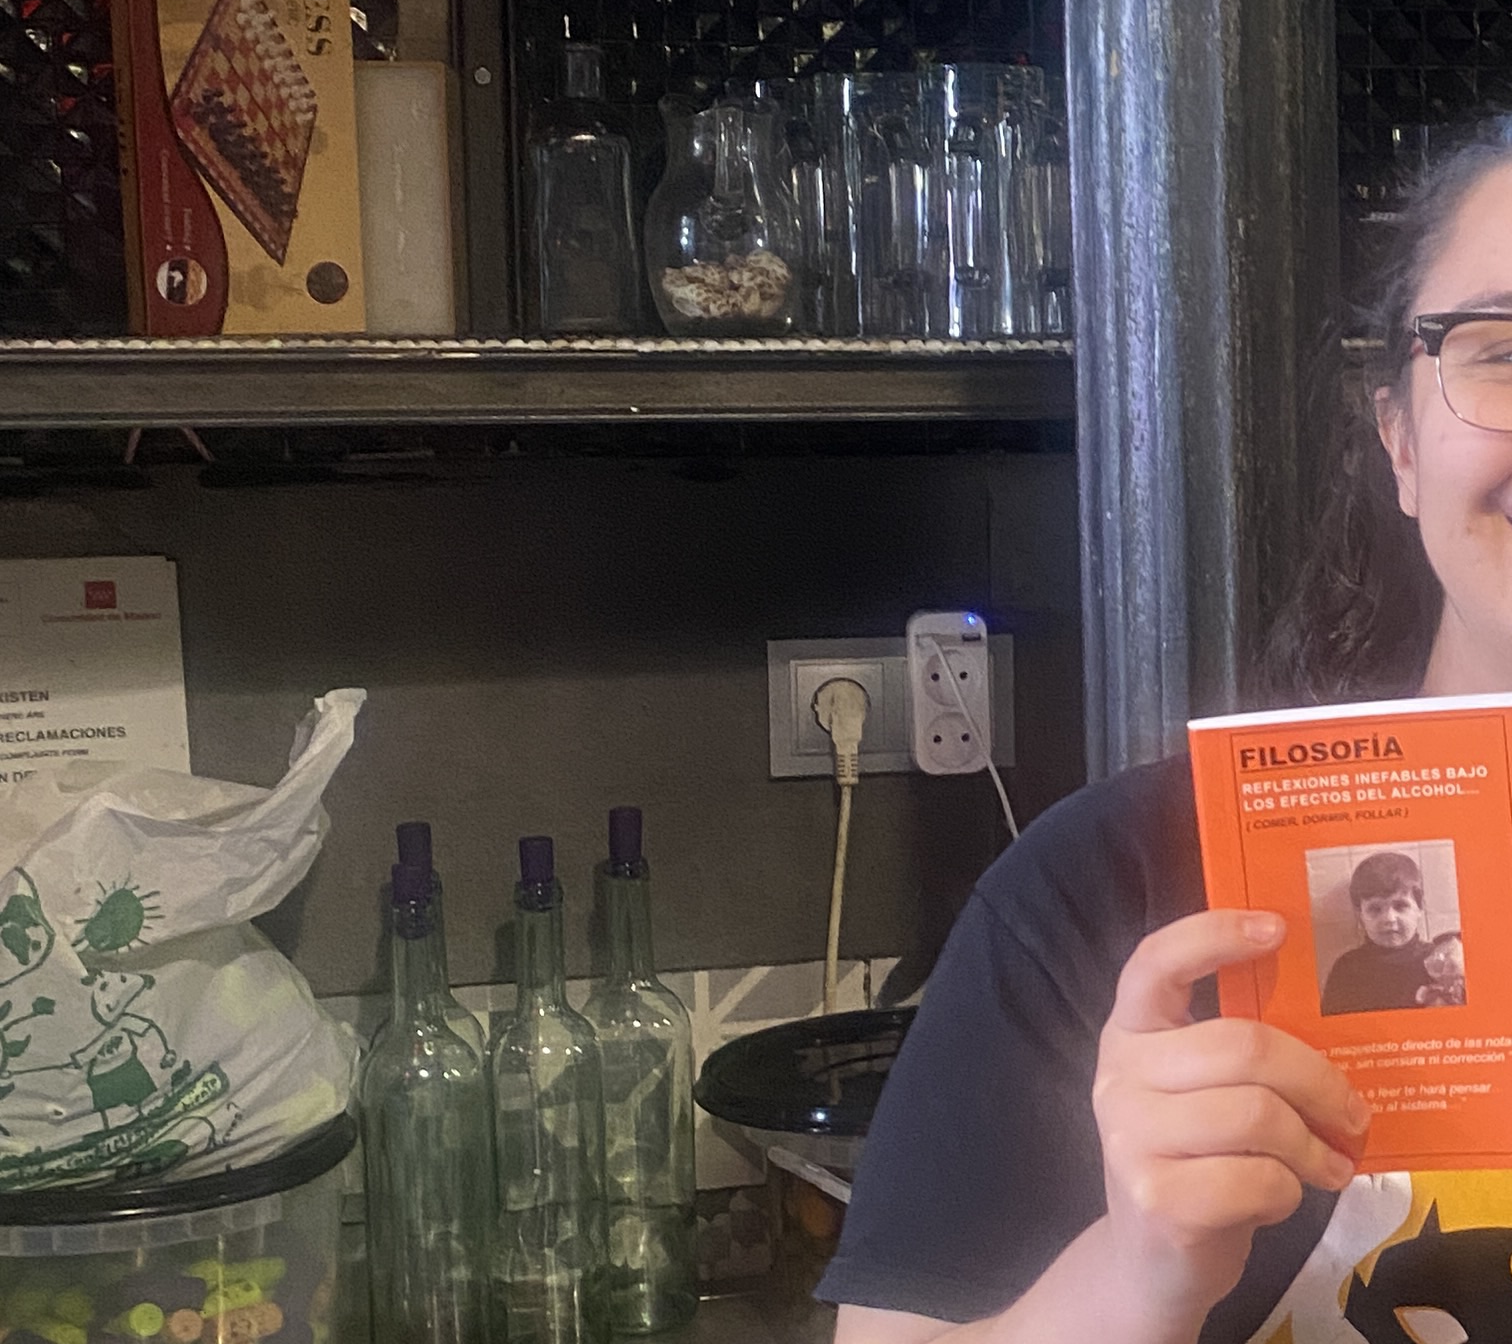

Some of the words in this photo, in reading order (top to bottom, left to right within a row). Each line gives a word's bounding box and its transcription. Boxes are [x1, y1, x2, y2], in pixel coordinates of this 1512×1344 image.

[1239, 732, 1404, 769] FILOSOFÍA
[1241, 774, 1350, 796] REFLEXIONES
[1354, 768, 1441, 786] INEFABLES
[1445, 765, 1488, 780] BAJO
[1243, 796, 1275, 812] LOS
[1279, 789, 1351, 809] EFECTOS
[1356, 787, 1387, 802] DEL
[1401, 1038, 1443, 1052] directo
[1445, 1037, 1462, 1050] de
